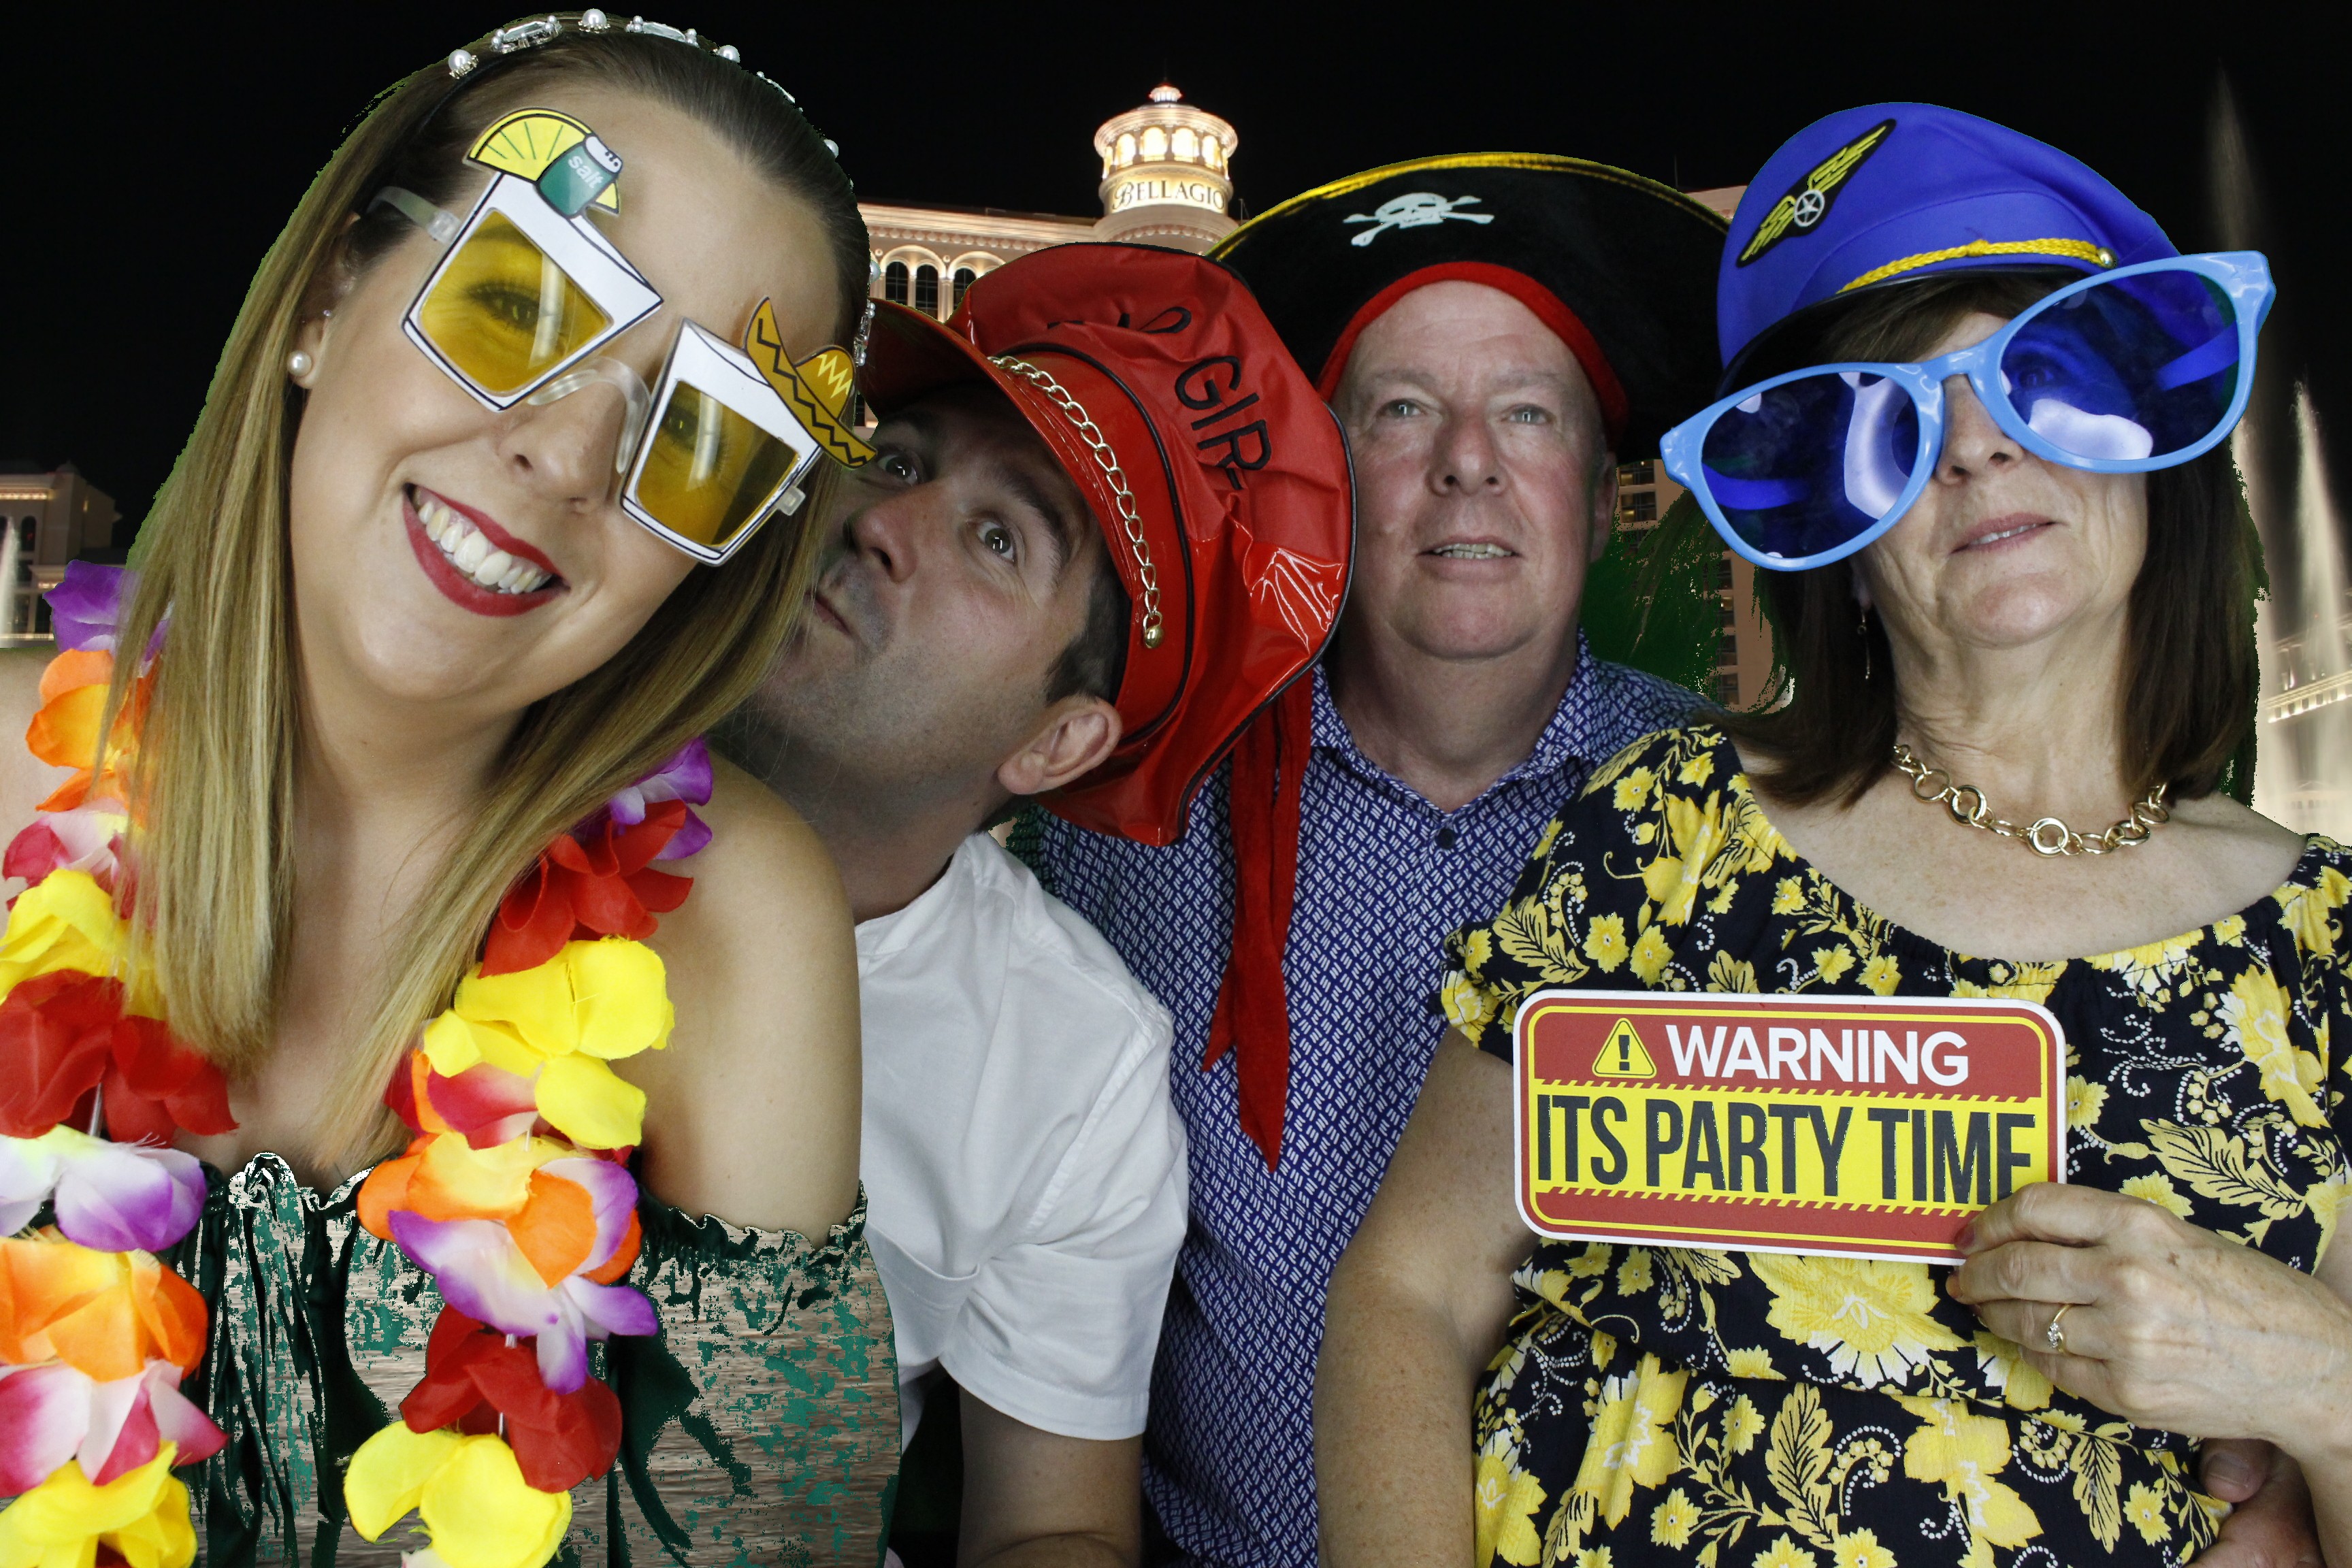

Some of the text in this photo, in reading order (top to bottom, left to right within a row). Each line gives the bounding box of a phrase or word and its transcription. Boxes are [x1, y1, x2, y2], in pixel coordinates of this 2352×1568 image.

[568, 156, 604, 189] salt
[1111, 180, 1225, 210] BELLAGIO
[1665, 1024, 1970, 1086] WARNING
[1537, 1094, 1628, 1186] ITS
[1645, 1098, 1853, 1197] PARTY
